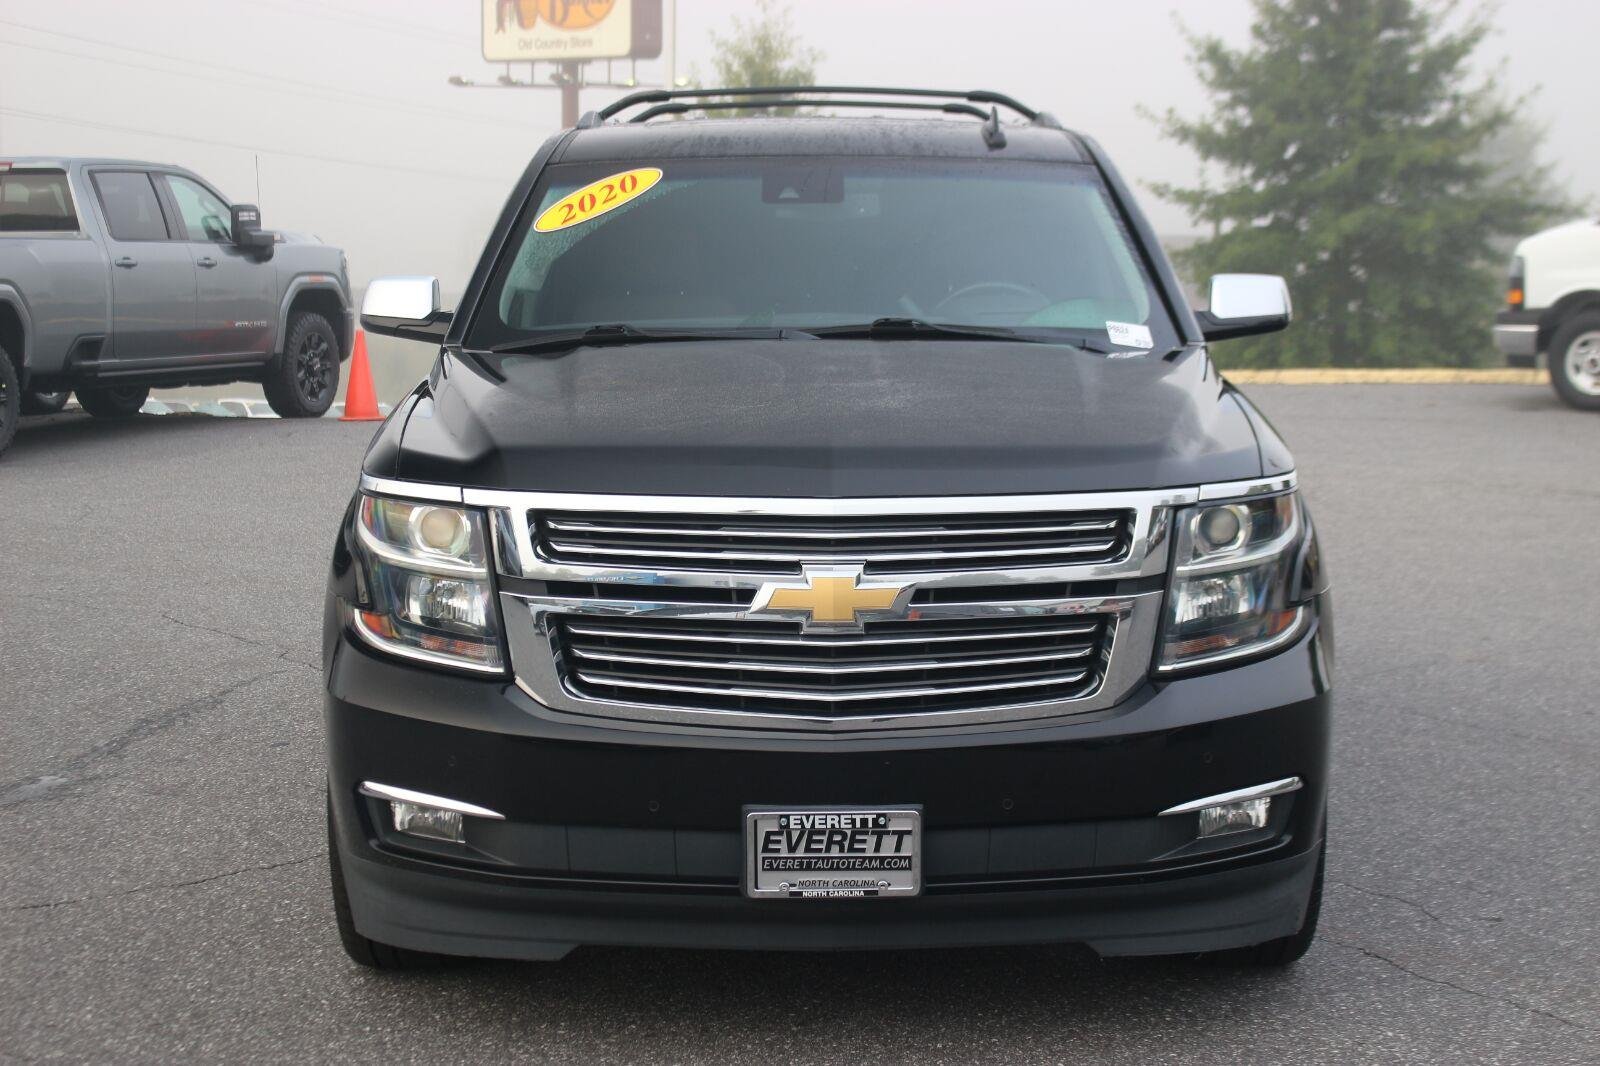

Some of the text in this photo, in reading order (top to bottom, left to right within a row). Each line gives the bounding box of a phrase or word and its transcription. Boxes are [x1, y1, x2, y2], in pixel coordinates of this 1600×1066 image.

[518, 37, 593, 51] Old Country Store
[558, 174, 638, 225] 2020
[789, 814, 877, 829] EVERETT
[761, 829, 912, 853] EVERETT
[763, 858, 909, 870] EVERETTAUTOTEAM.COM
[798, 879, 876, 888] NORTH CAROLINA
